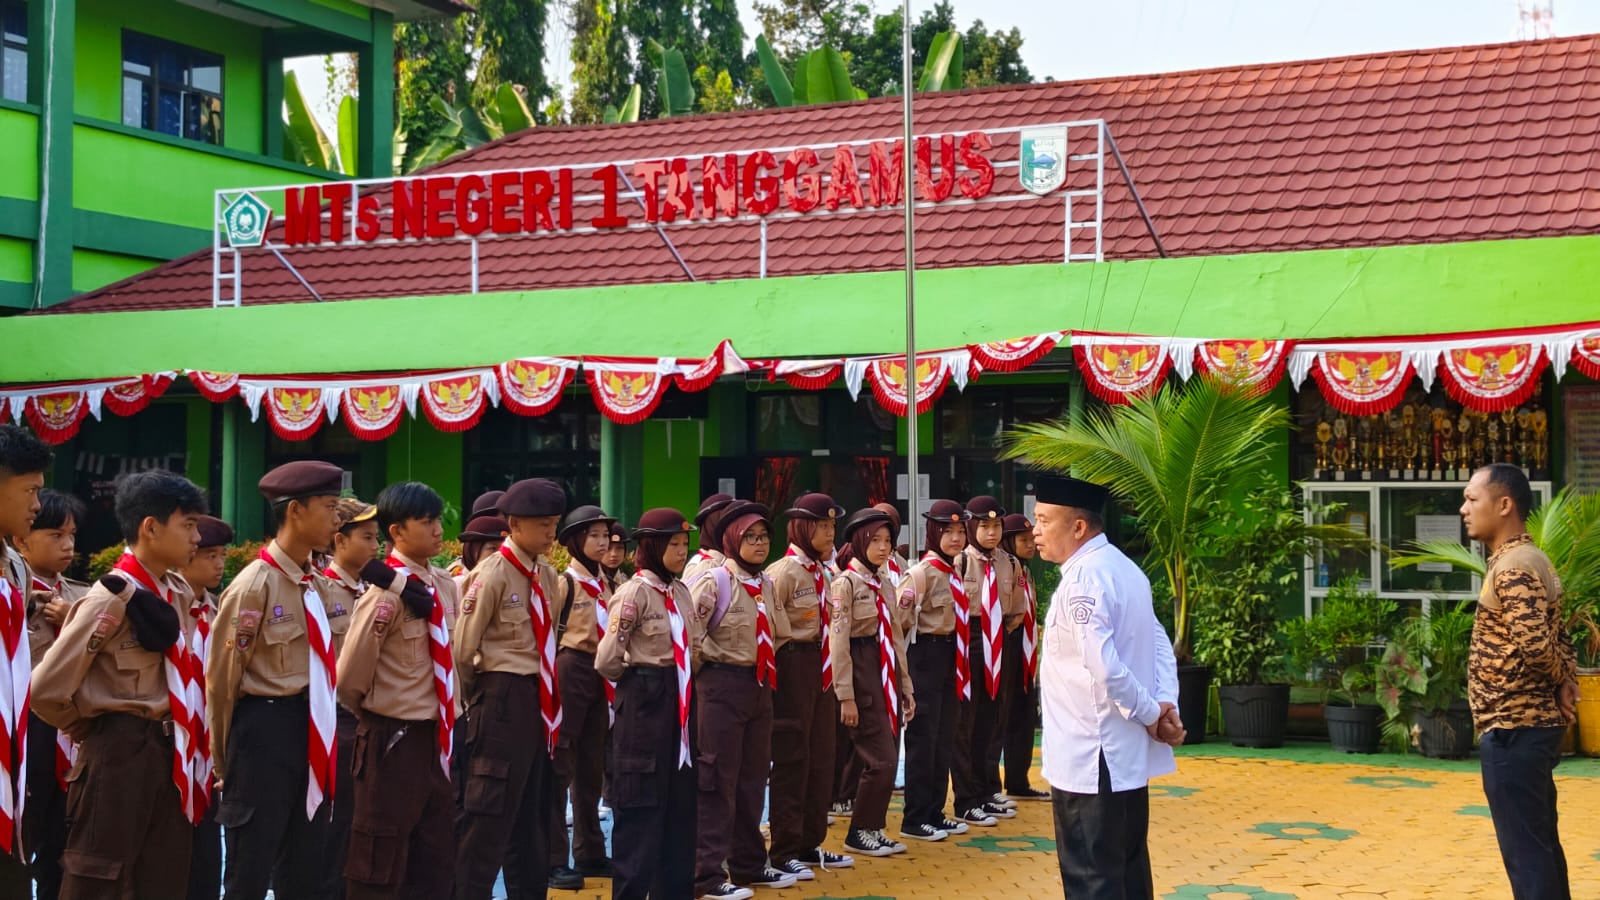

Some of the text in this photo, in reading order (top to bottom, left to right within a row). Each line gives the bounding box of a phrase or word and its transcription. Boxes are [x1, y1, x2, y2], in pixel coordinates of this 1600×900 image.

[284, 131, 994, 246] MTs NEGERI 1 TANGGAMUS
